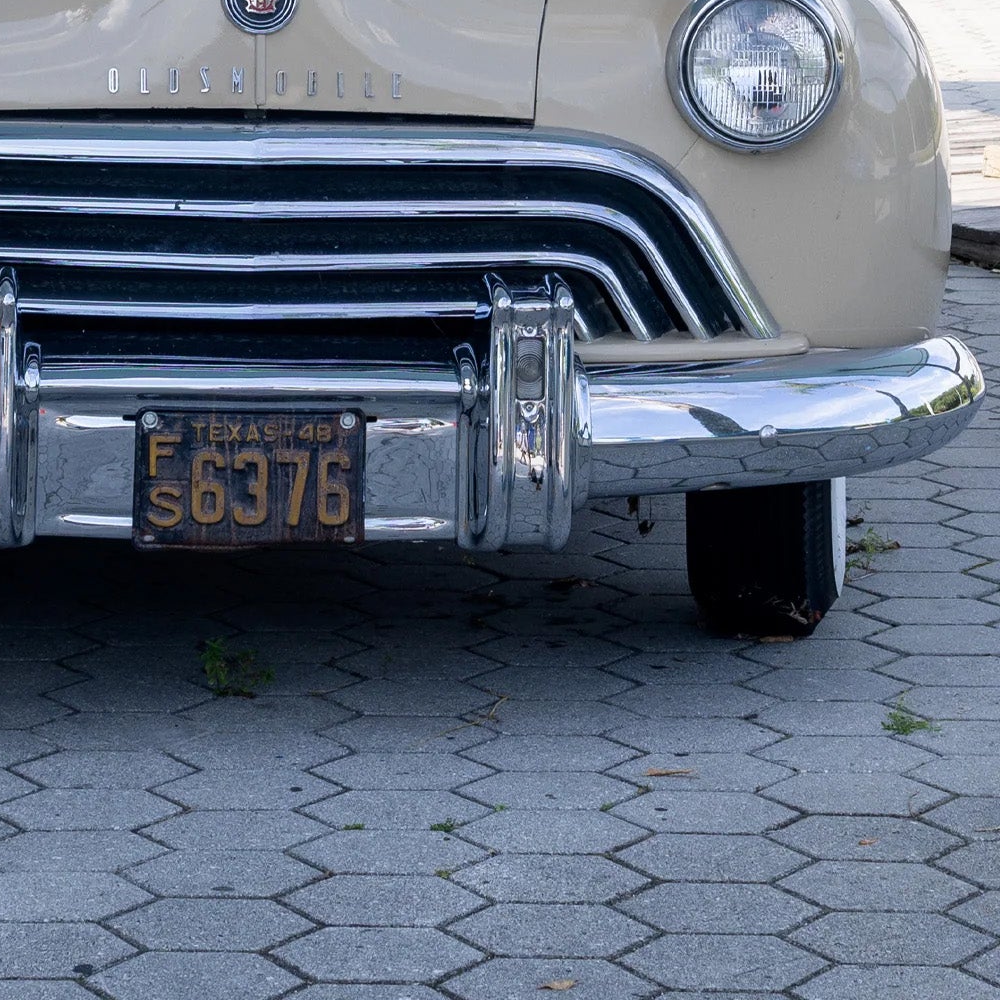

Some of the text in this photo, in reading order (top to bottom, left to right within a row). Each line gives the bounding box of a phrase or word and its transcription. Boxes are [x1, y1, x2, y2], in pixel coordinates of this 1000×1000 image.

[107, 66, 402, 99] OLDSMOBILE
[148, 434, 182, 478] F
[147, 486, 183, 527] S
[191, 450, 351, 526] 6376
